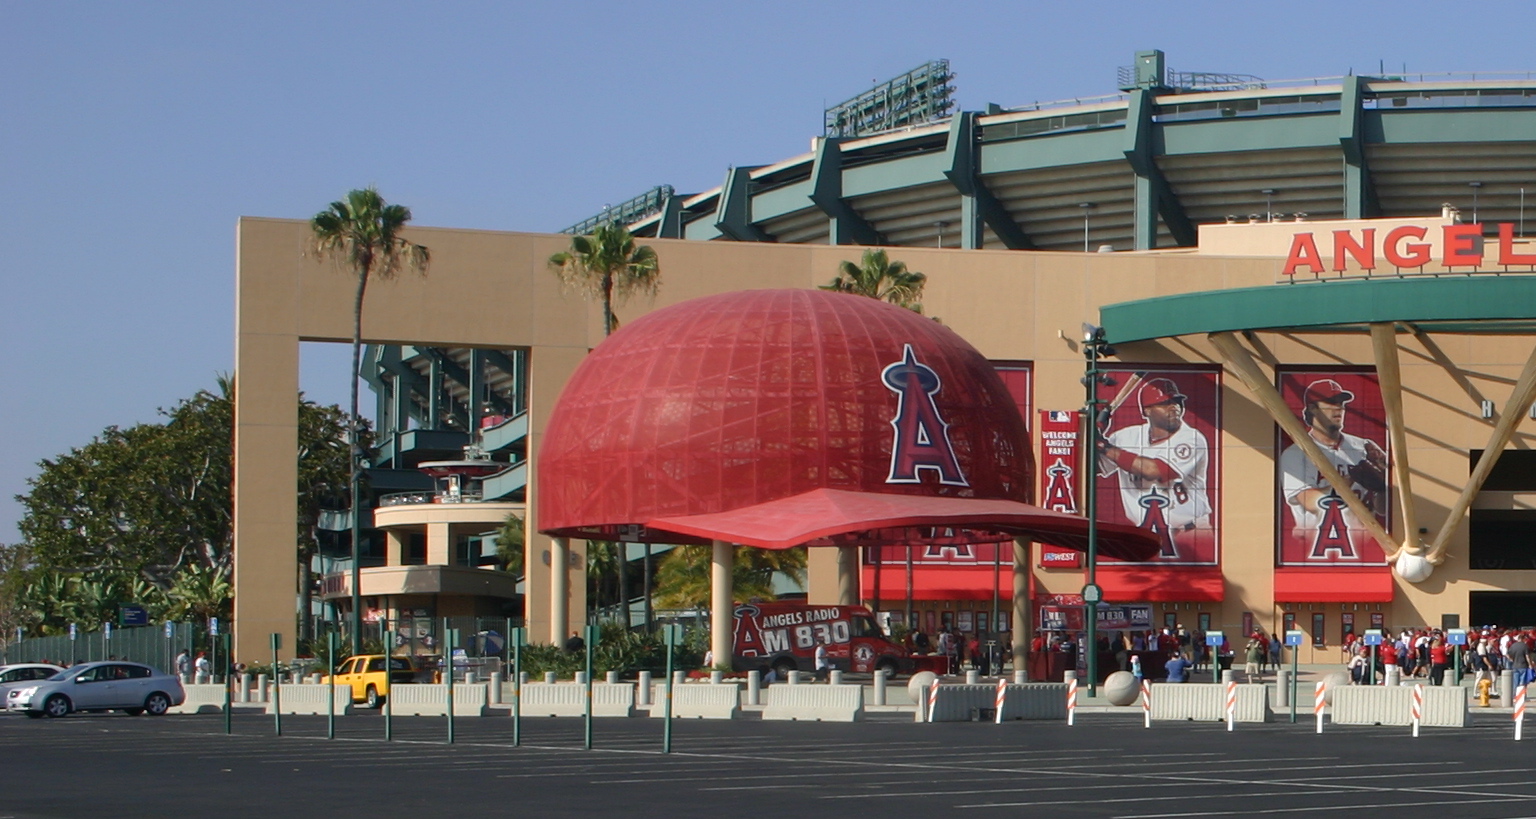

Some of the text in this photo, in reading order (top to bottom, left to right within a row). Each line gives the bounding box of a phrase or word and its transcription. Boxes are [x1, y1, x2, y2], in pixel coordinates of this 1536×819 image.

[881, 343, 970, 487] A
[1042, 431, 1077, 439] WELCOME
[1046, 439, 1074, 447] ANGELS
[762, 607, 840, 629] ANGELS RADIO
[1131, 610, 1148, 619] FAN
[795, 620, 850, 649] 830
